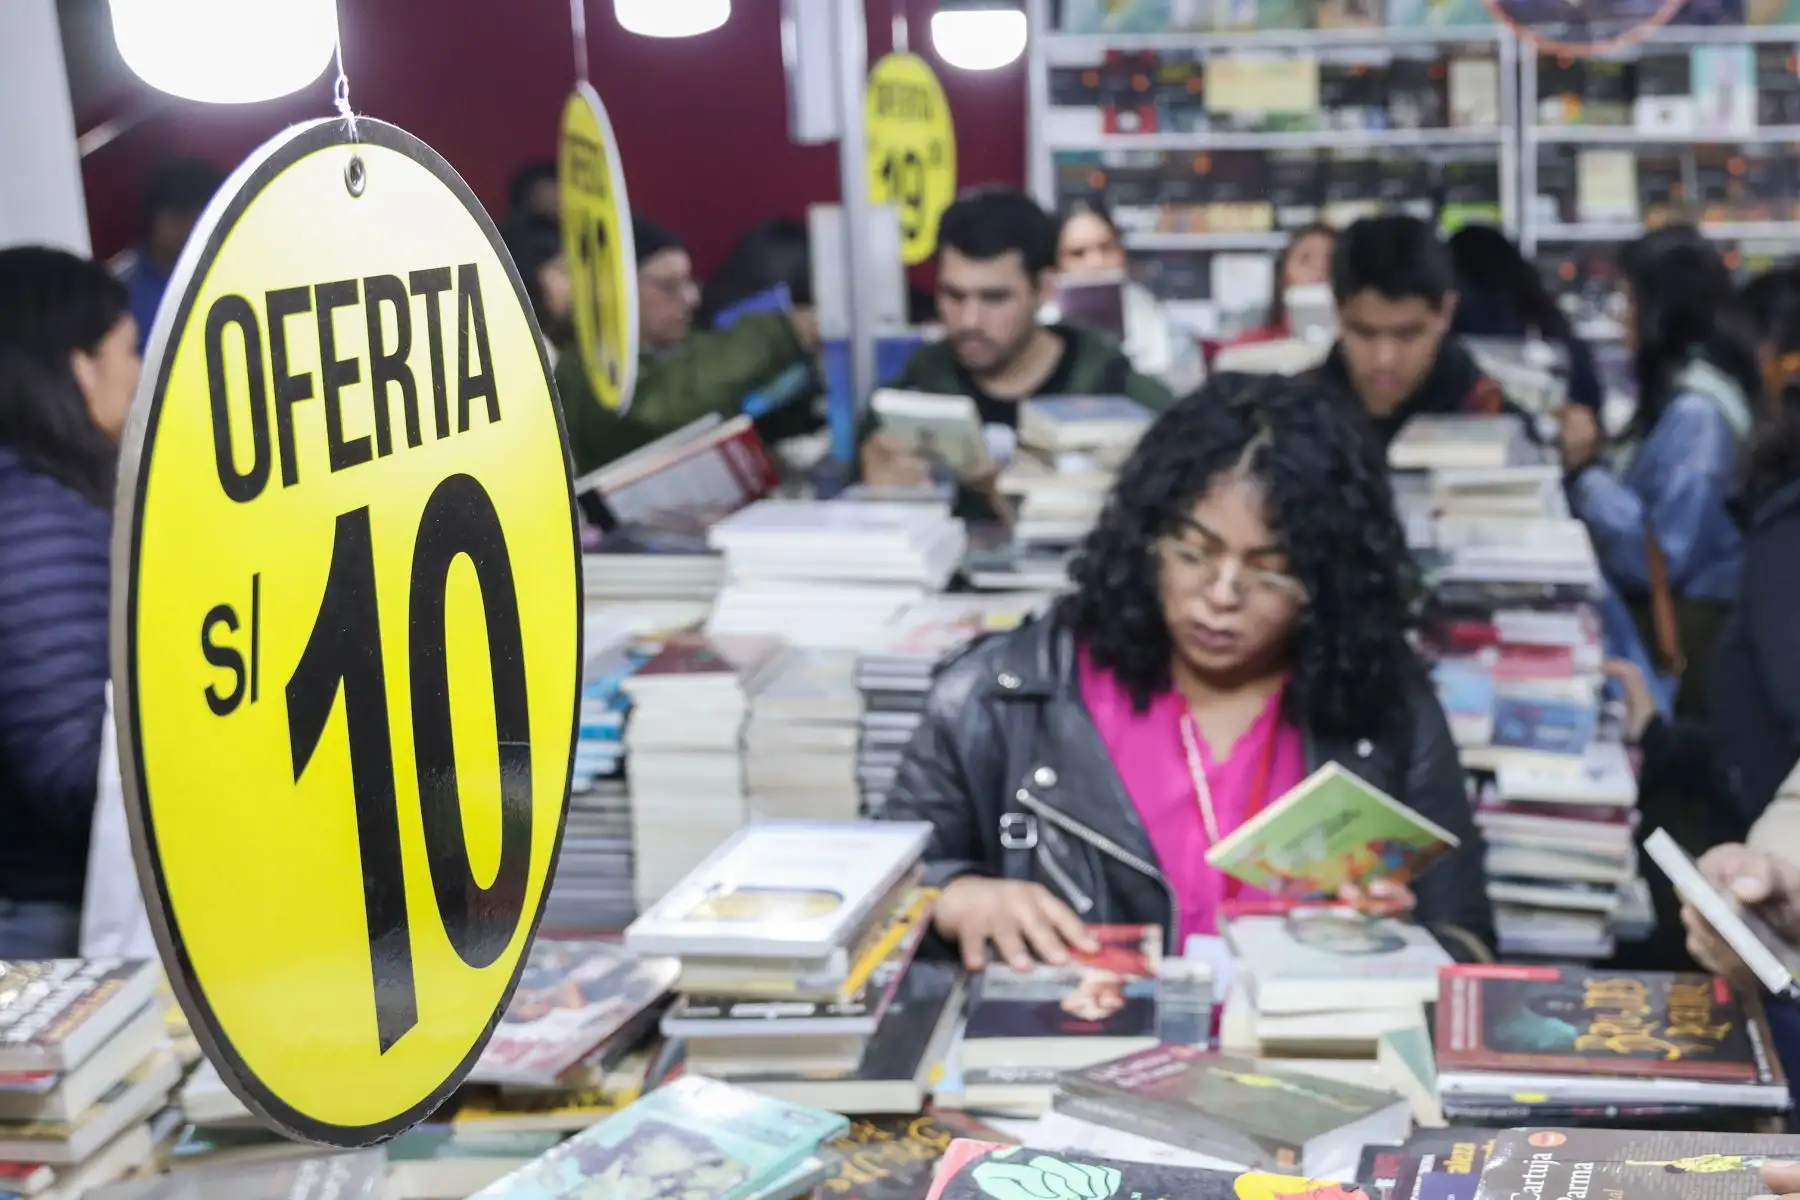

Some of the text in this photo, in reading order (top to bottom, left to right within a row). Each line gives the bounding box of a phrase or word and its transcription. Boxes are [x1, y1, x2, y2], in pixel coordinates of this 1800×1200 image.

[204, 262, 502, 504] OFERTA
[200, 472, 533, 1056] S/ 10
